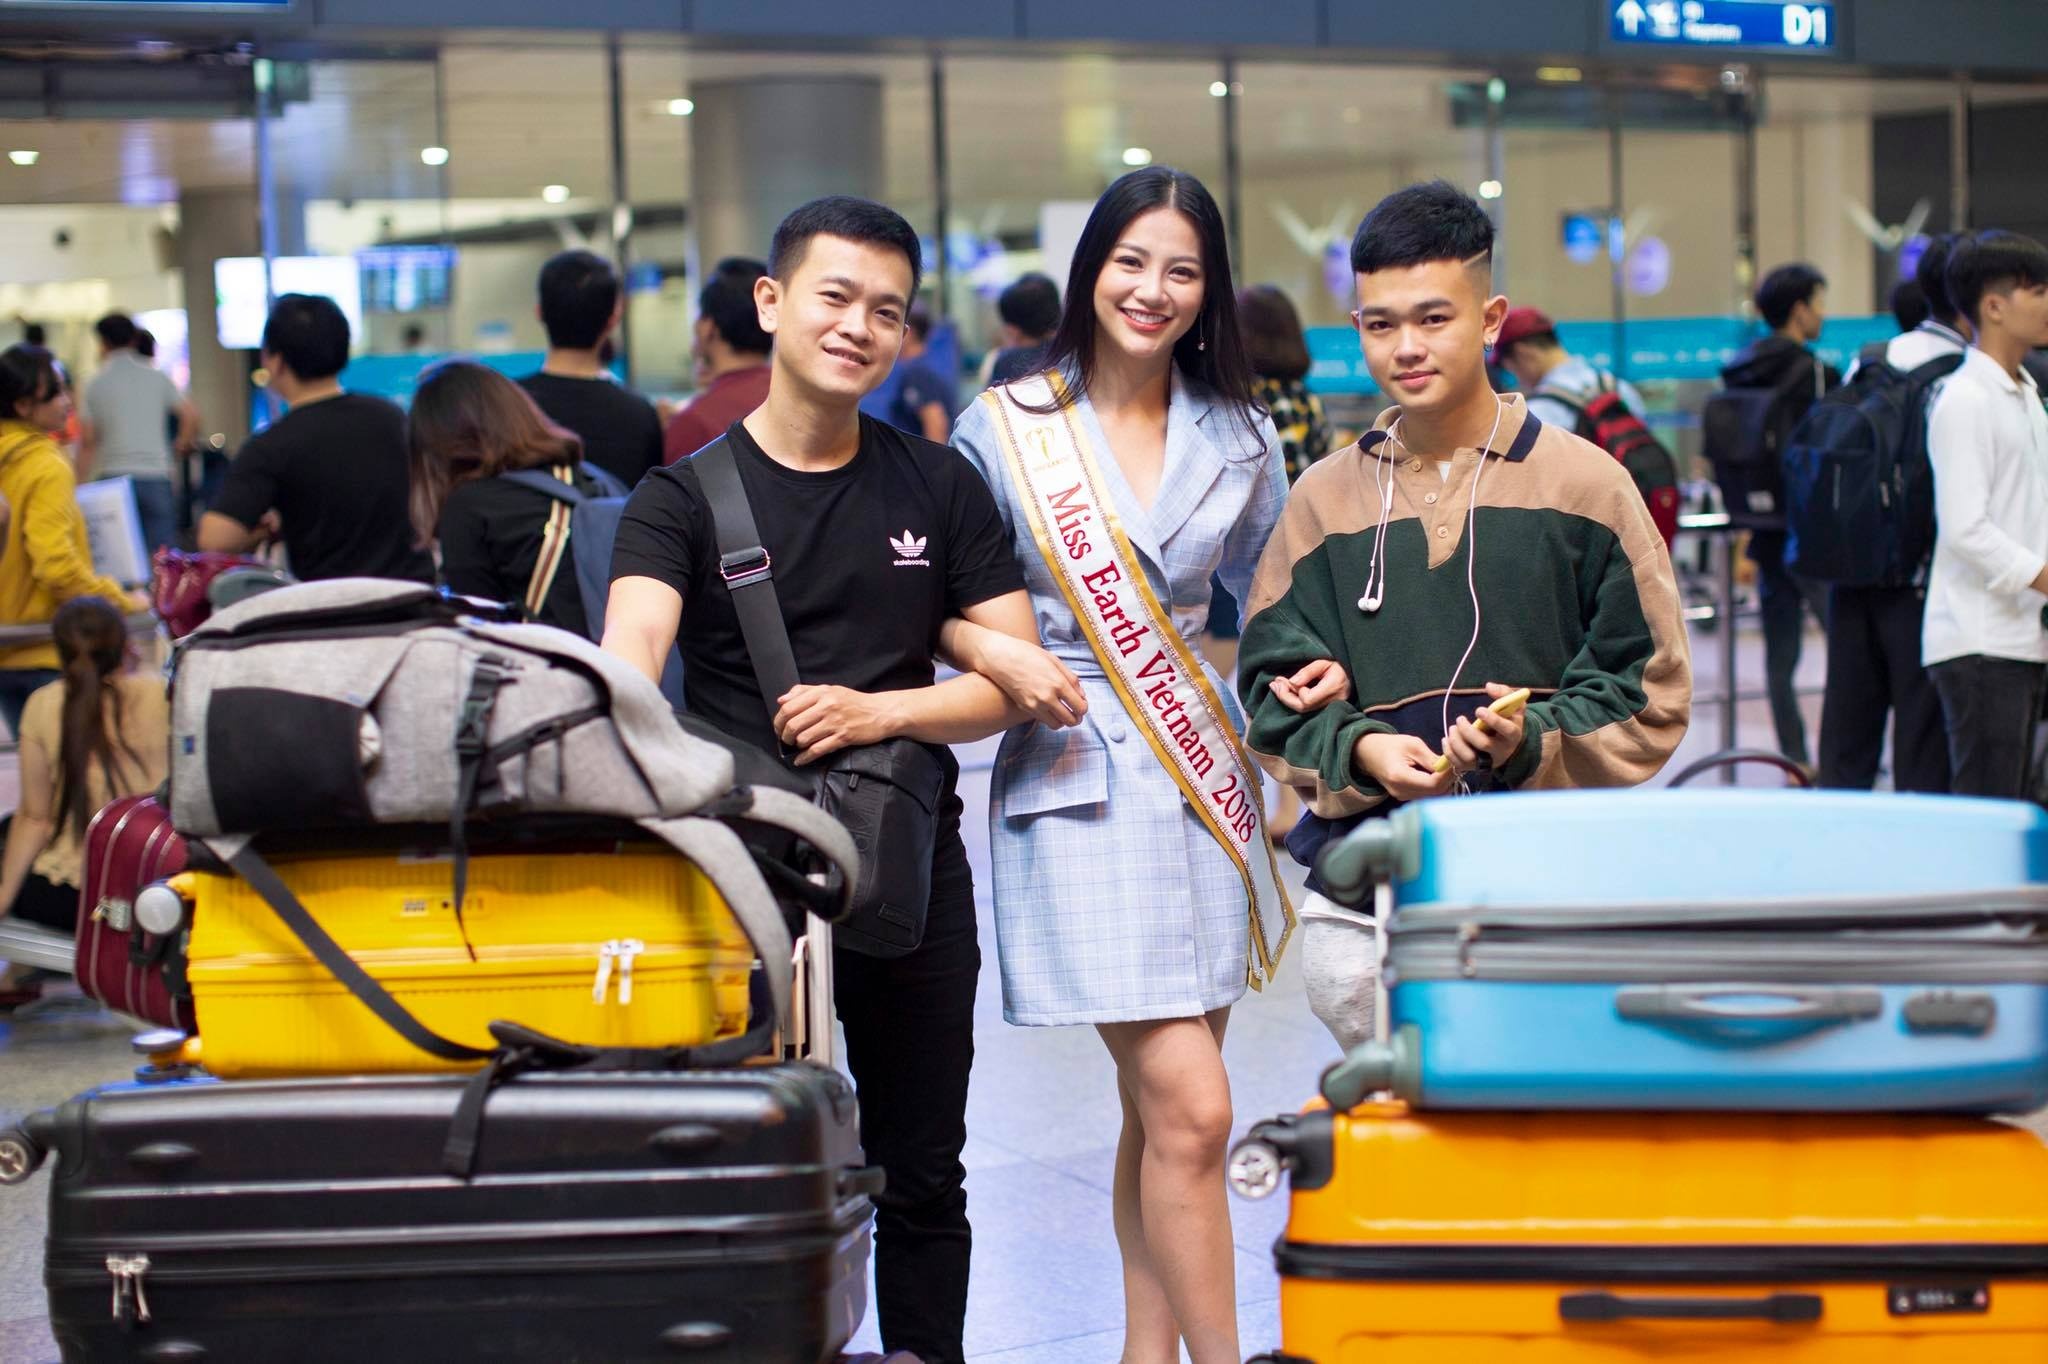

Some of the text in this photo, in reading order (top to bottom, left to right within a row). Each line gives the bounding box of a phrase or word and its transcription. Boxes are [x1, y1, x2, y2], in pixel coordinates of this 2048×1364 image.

[1782, 4, 1826, 46] D1
[892, 558, 930, 567] skateboarding
[1047, 481, 1092, 560] Miss
[1081, 560, 1151, 658] Earth
[1135, 650, 1216, 780] Vietnam
[1211, 774, 1257, 843] 2018
